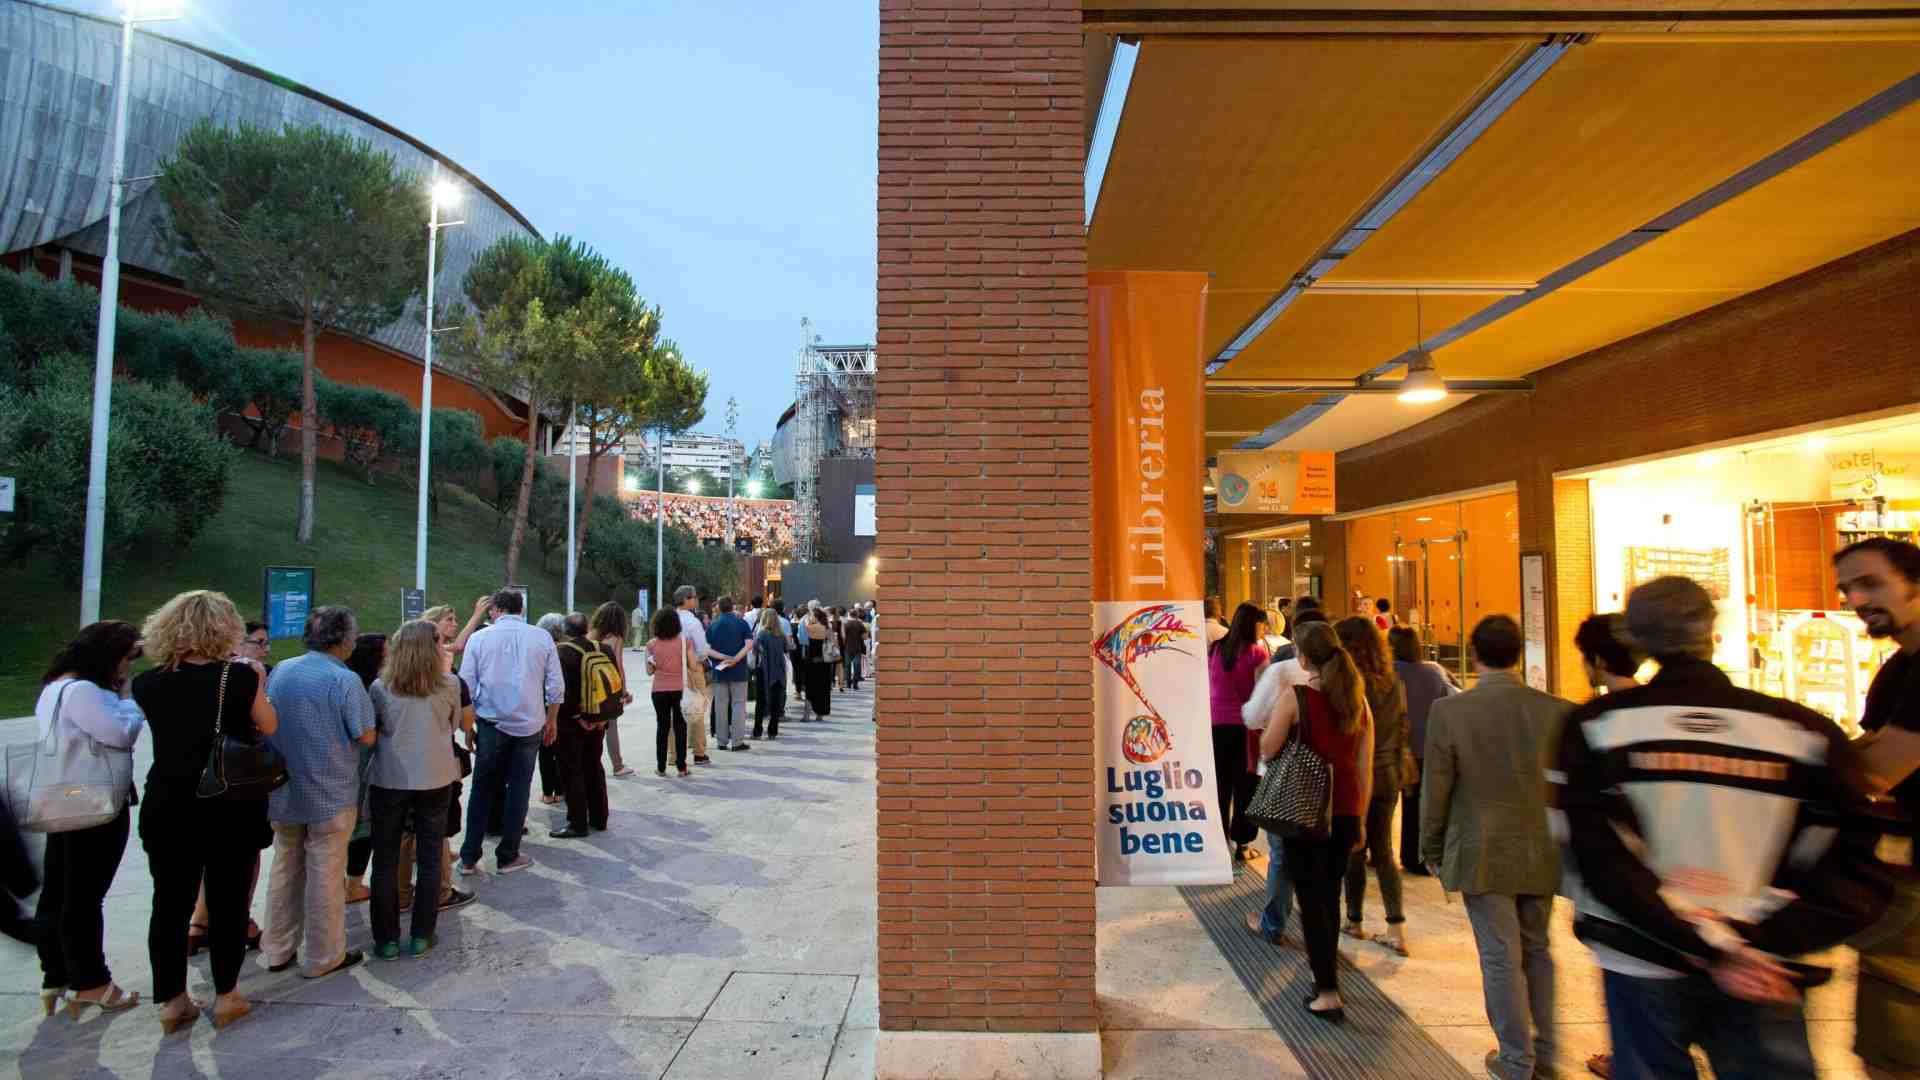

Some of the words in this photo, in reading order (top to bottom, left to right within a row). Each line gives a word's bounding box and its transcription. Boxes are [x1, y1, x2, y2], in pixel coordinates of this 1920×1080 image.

[1128, 386, 1166, 589] Libreria
[1107, 761, 1203, 798] Luglio
[1108, 800, 1207, 825] suona
[1119, 826, 1204, 856] bene
